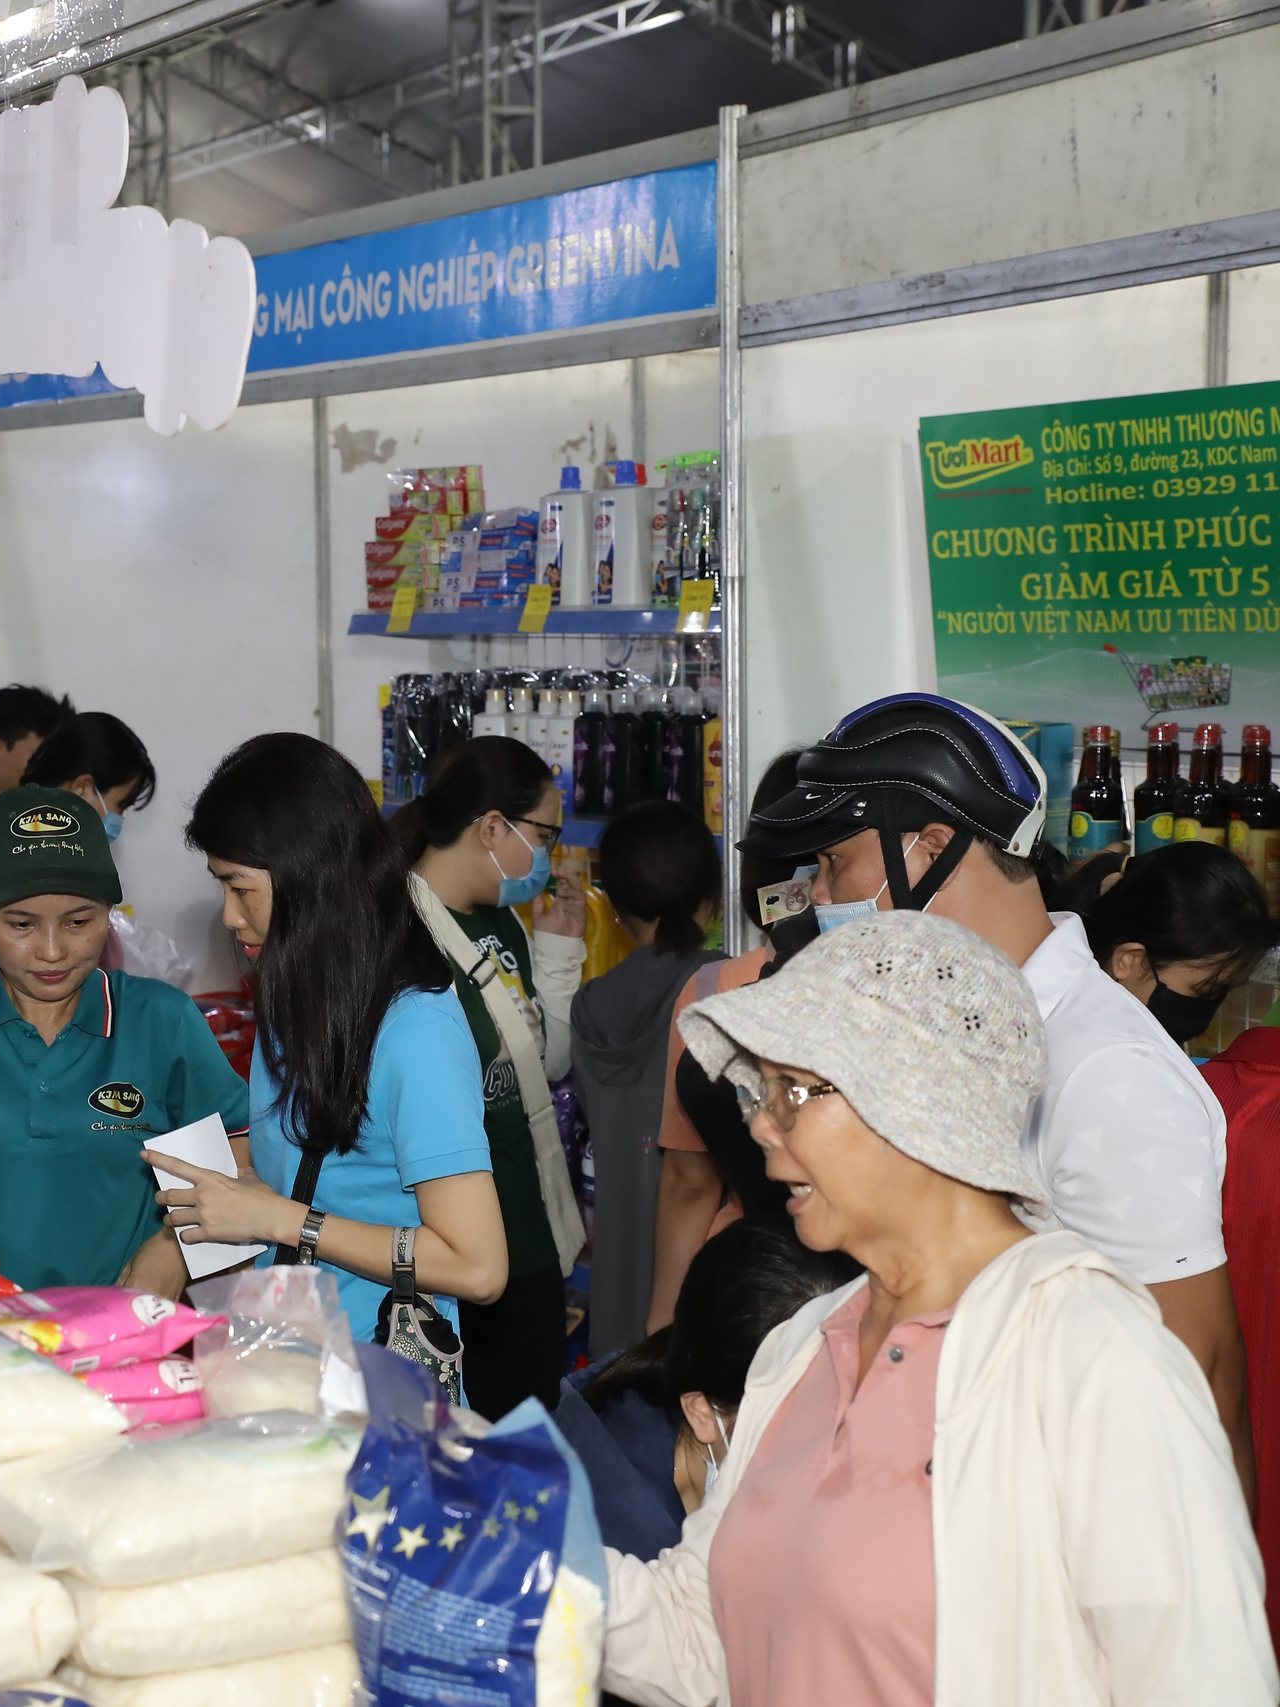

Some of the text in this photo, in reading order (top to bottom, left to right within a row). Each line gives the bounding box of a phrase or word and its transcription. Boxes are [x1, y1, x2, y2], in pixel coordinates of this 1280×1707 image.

[274, 284, 315, 345] MẠI
[320, 262, 393, 327] CÔNG
[398, 237, 498, 318] NGHIỆP
[505, 216, 680, 296] GREENVINA
[1041, 419, 1091, 454] CÔNG
[1094, 421, 1116, 449] TY
[1119, 416, 1172, 447] TNHH
[1175, 407, 1265, 442] THƯƠNG
[1042, 444, 1278, 482] Địa Chỉ: Số 9, đường 23, KDC Nam
[1045, 483, 1145, 505] Hotline:
[1152, 474, 1237, 499] 03929
[376, 517, 406, 532] Colgate
[932, 505, 1272, 559] CHƯƠNG TRÌNH PHÚC
[366, 543, 396, 557] Colgate
[366, 567, 397, 581] Colgate
[1021, 556, 1270, 601] GIẢM GIÁ TỪ 5
[1020, 603, 1070, 641] VIỆT
[1076, 609, 1132, 634] NAM
[1137, 608, 1172, 634] ƯU
[1177, 600, 1237, 633] TIÊN
[18, 814, 42, 825] KIM
[98, 1090, 121, 1100] KIM
